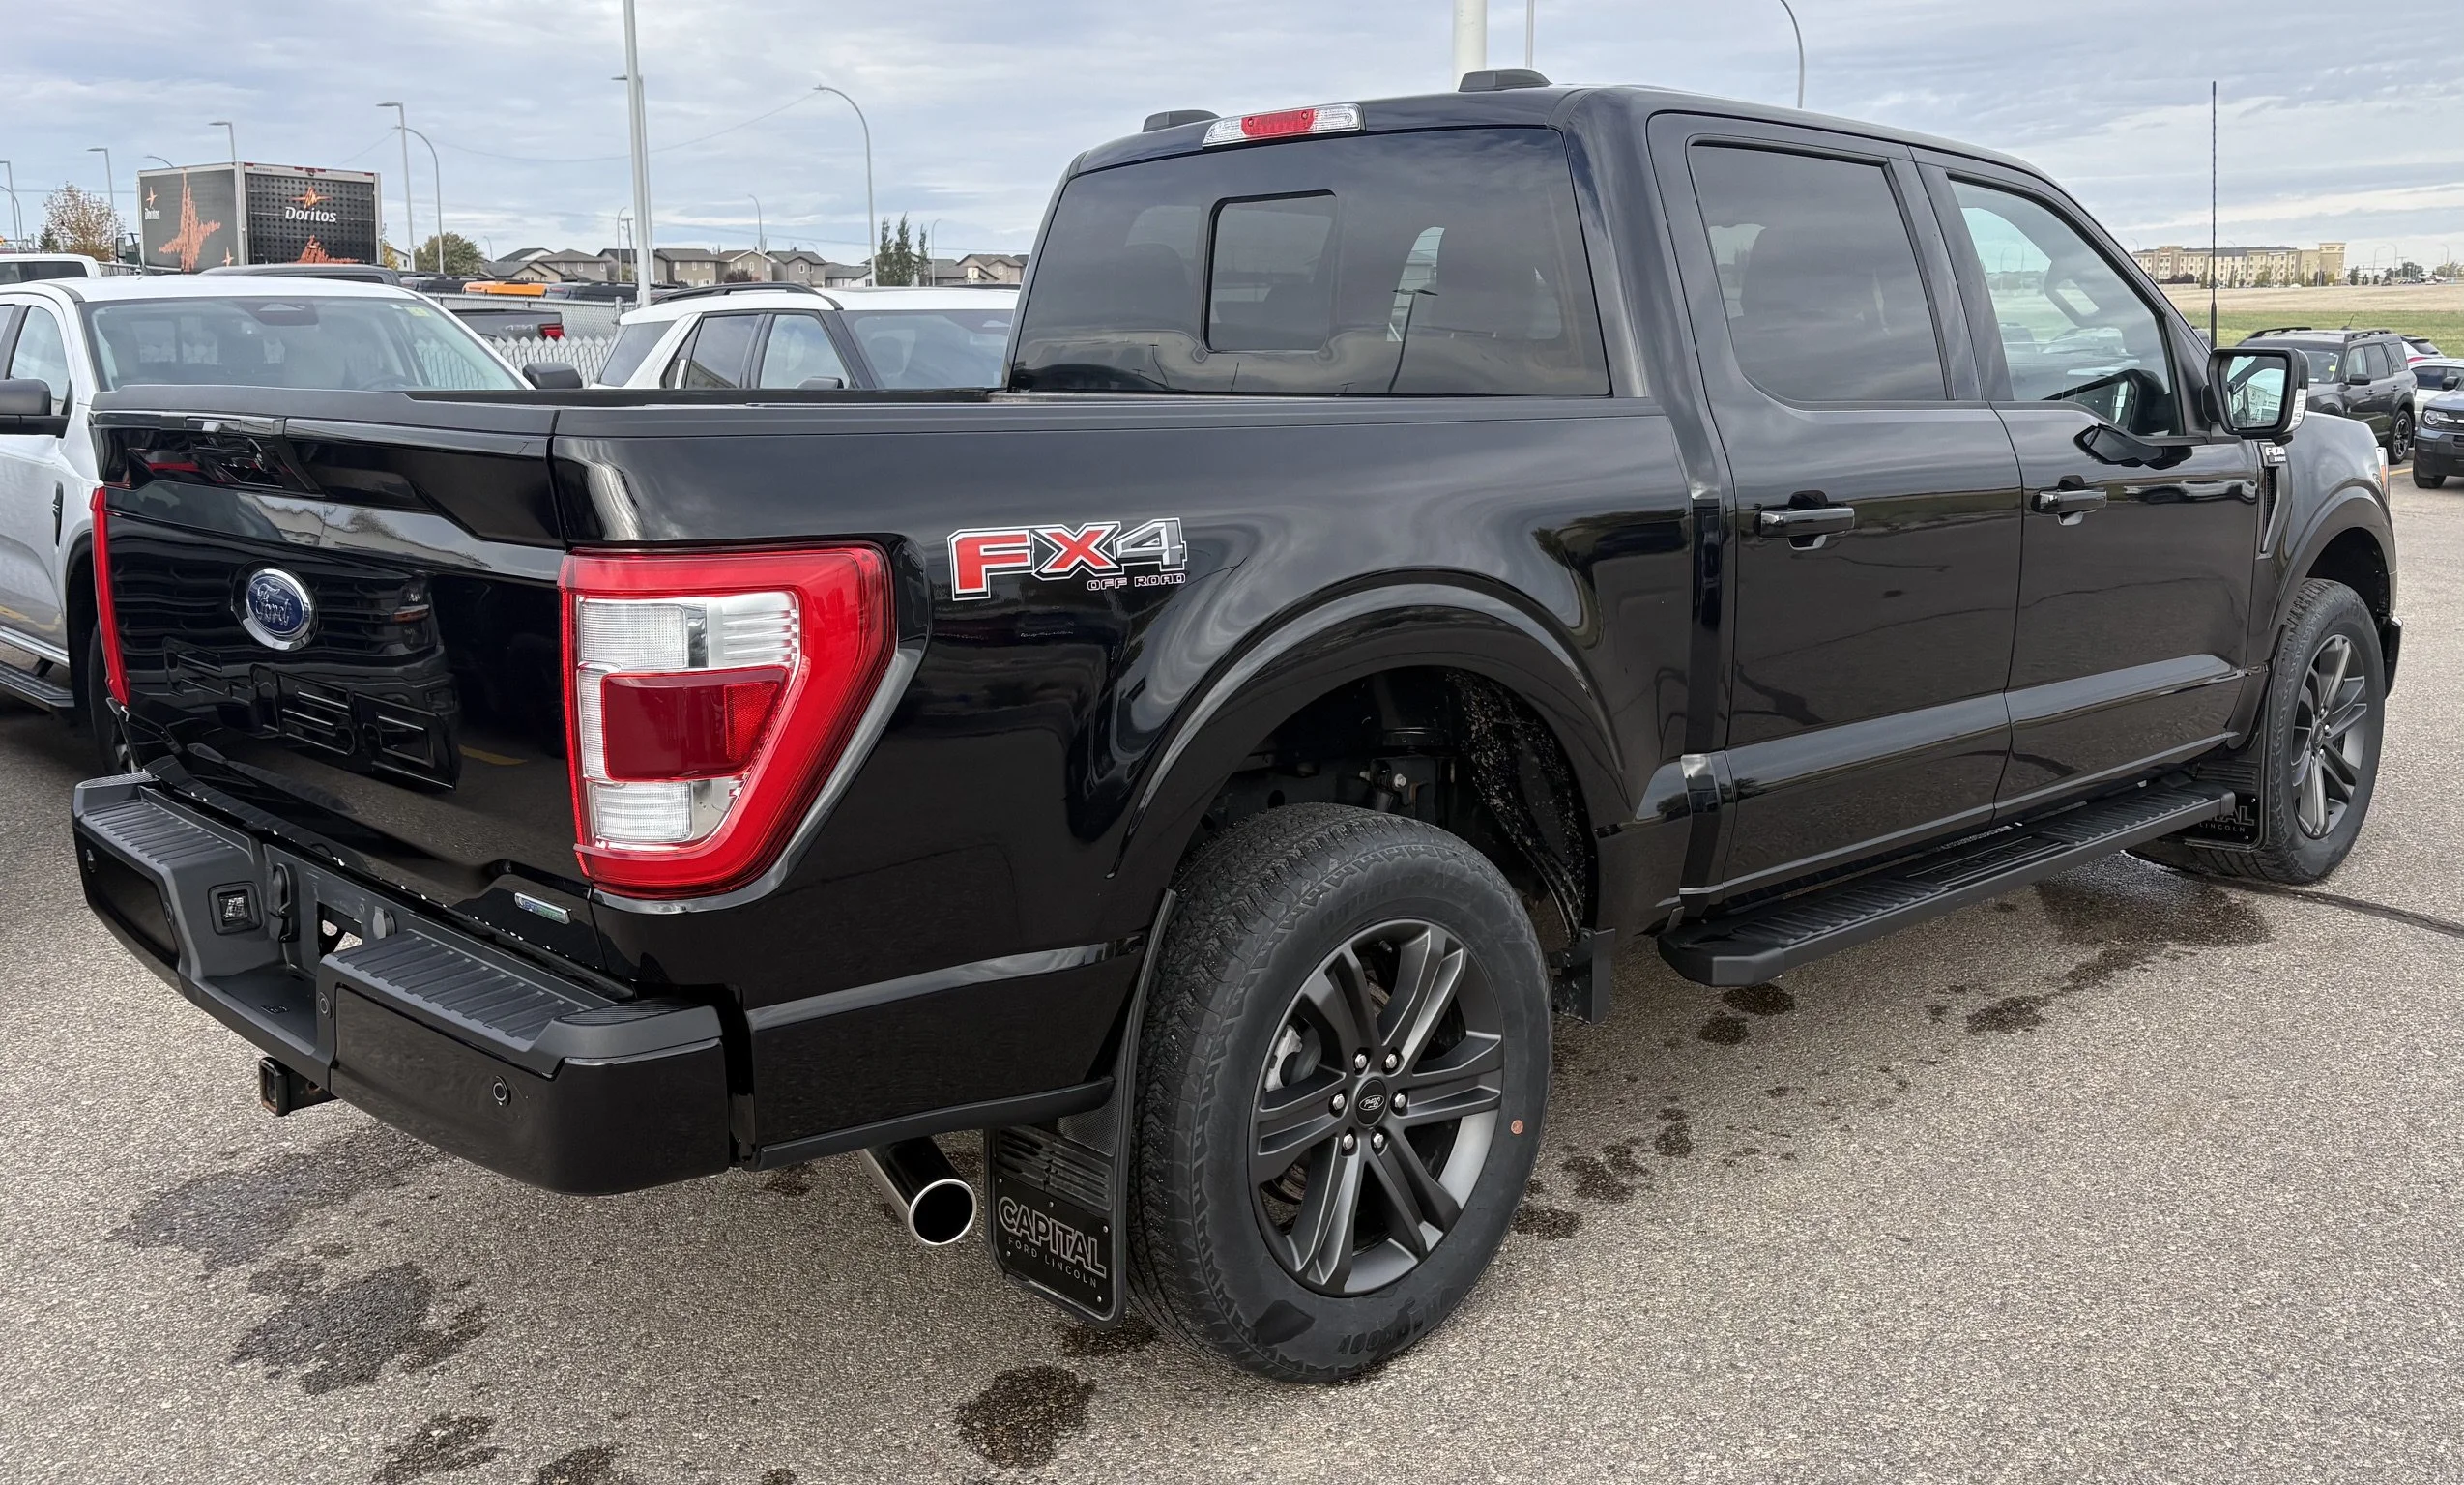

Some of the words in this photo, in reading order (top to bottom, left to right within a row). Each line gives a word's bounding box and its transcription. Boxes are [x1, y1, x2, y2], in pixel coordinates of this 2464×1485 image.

[285, 206, 337, 223] Doritos
[947, 518, 1187, 601] FX4
[255, 582, 290, 626] Ford
[1087, 577, 1128, 591] OFF
[1134, 573, 1186, 588] ROAD
[2199, 822, 2246, 832] LINCOLN
[999, 1196, 1107, 1279] CAPITAL
[1008, 1237, 1038, 1258] FORD
[1045, 1254, 1097, 1288] LINCOLN
